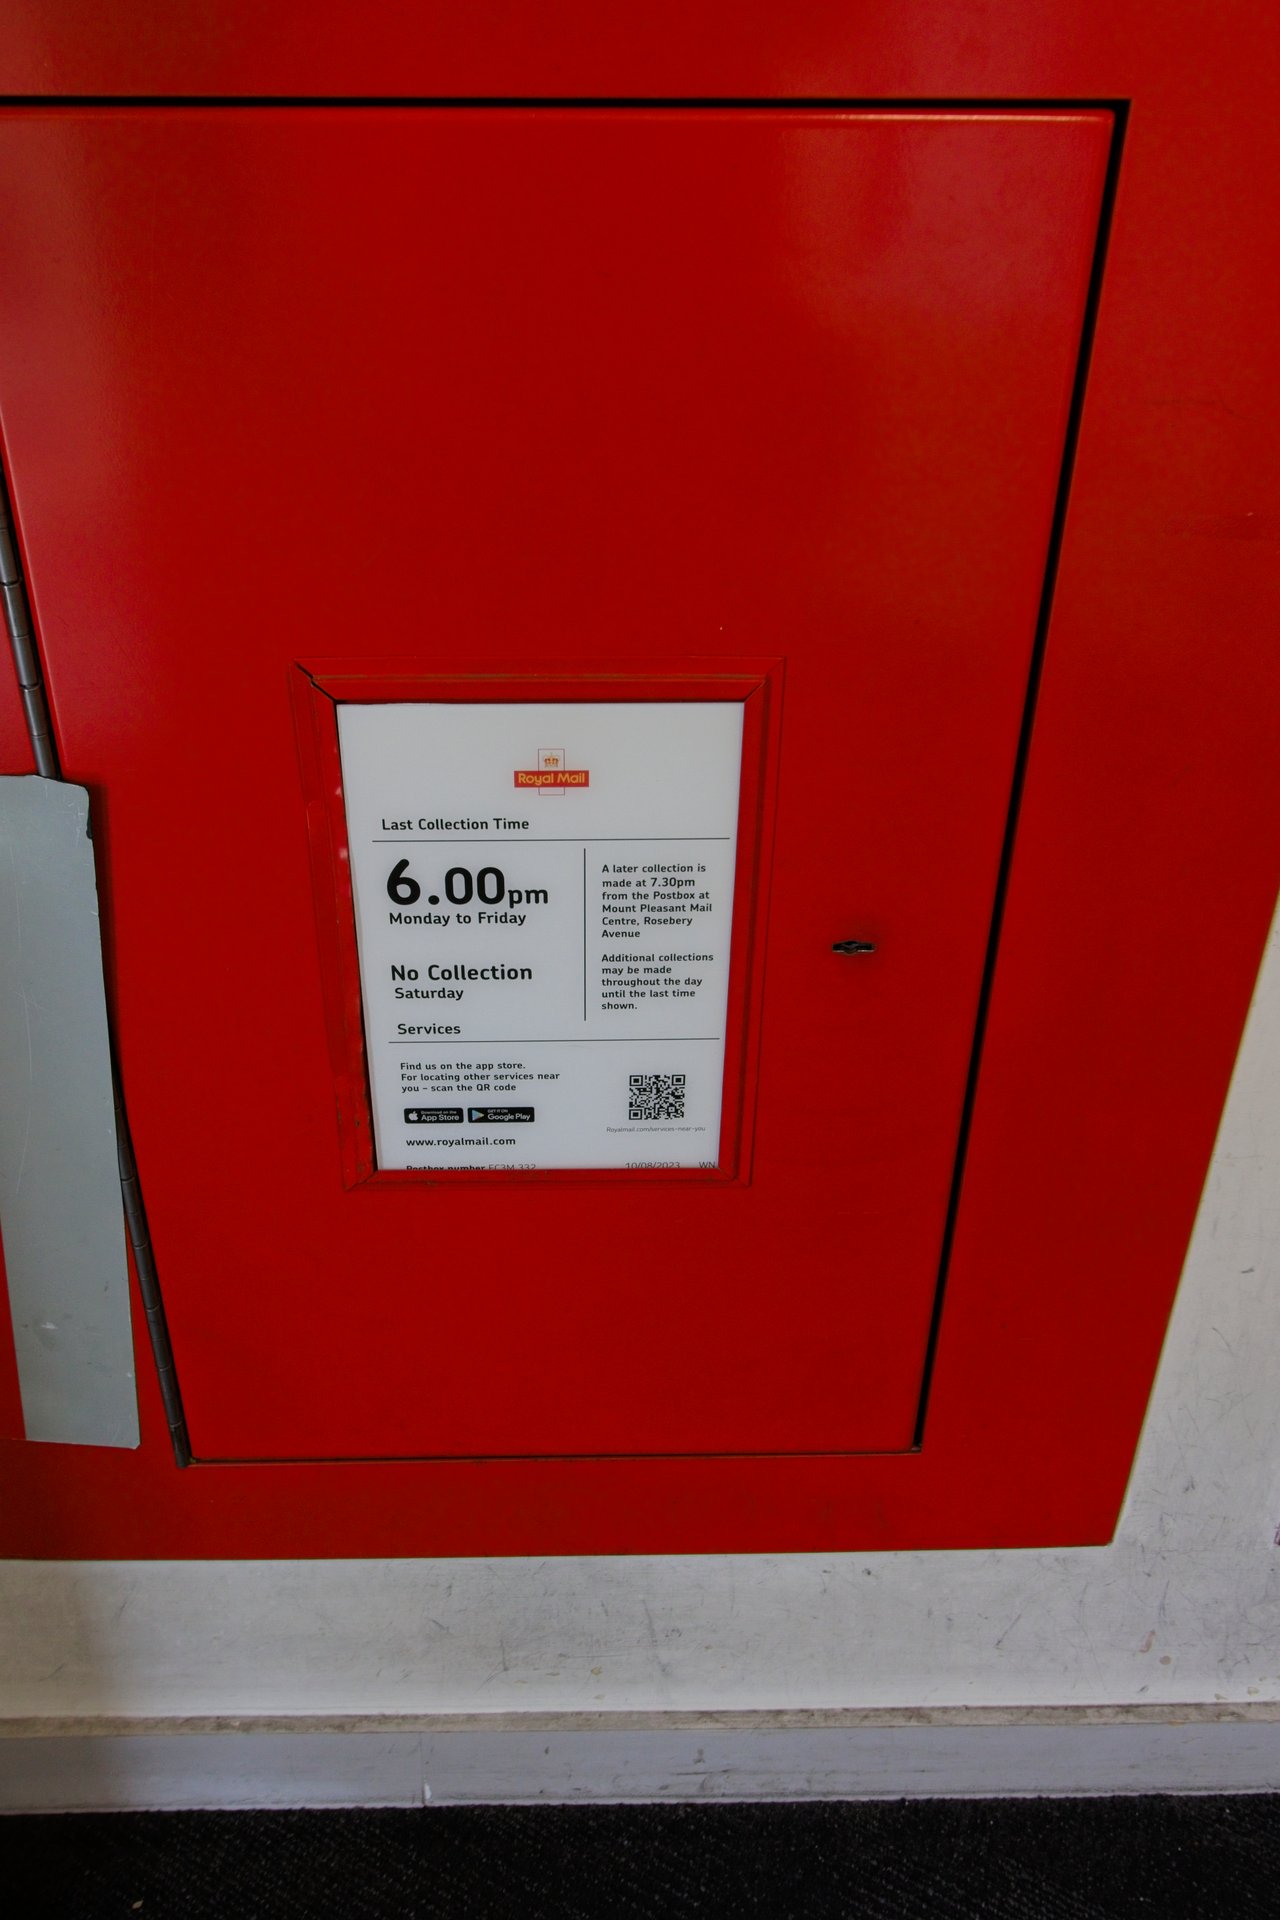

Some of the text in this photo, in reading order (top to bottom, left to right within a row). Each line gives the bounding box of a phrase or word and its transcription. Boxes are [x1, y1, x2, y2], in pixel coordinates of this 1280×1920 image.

[518, 773, 585, 785] Royal Mail
[382, 818, 529, 830] Last Collection Time
[602, 864, 706, 873] A later collection is
[387, 859, 548, 908] 6.00pm
[602, 879, 632, 887] made
[651, 877, 695, 888] 7.30pm
[602, 892, 627, 900] from
[632, 892, 649, 900] the
[654, 891, 695, 900] Postbox
[602, 903, 712, 912] Mount Pleasant Mail
[390, 912, 526, 926] Monday to Friday
[602, 916, 692, 926] Centre, Rosebery
[602, 930, 640, 938] Avenue
[602, 953, 713, 962] Additional collections
[391, 964, 532, 981] No Collection
[602, 966, 672, 976] may be made
[602, 978, 660, 988] throughout
[684, 977, 702, 986] day
[395, 988, 464, 1001] Saturday
[602, 990, 625, 998] until
[629, 990, 646, 998] the
[672, 989, 695, 997] time
[398, 1023, 460, 1034] Services
[400, 1062, 422, 1070] Find
[421, 1073, 460, 1082] locating
[494, 1072, 534, 1080] services
[488, 1113, 513, 1121] Google
[406, 1137, 515, 1147] www.royalmail.com
